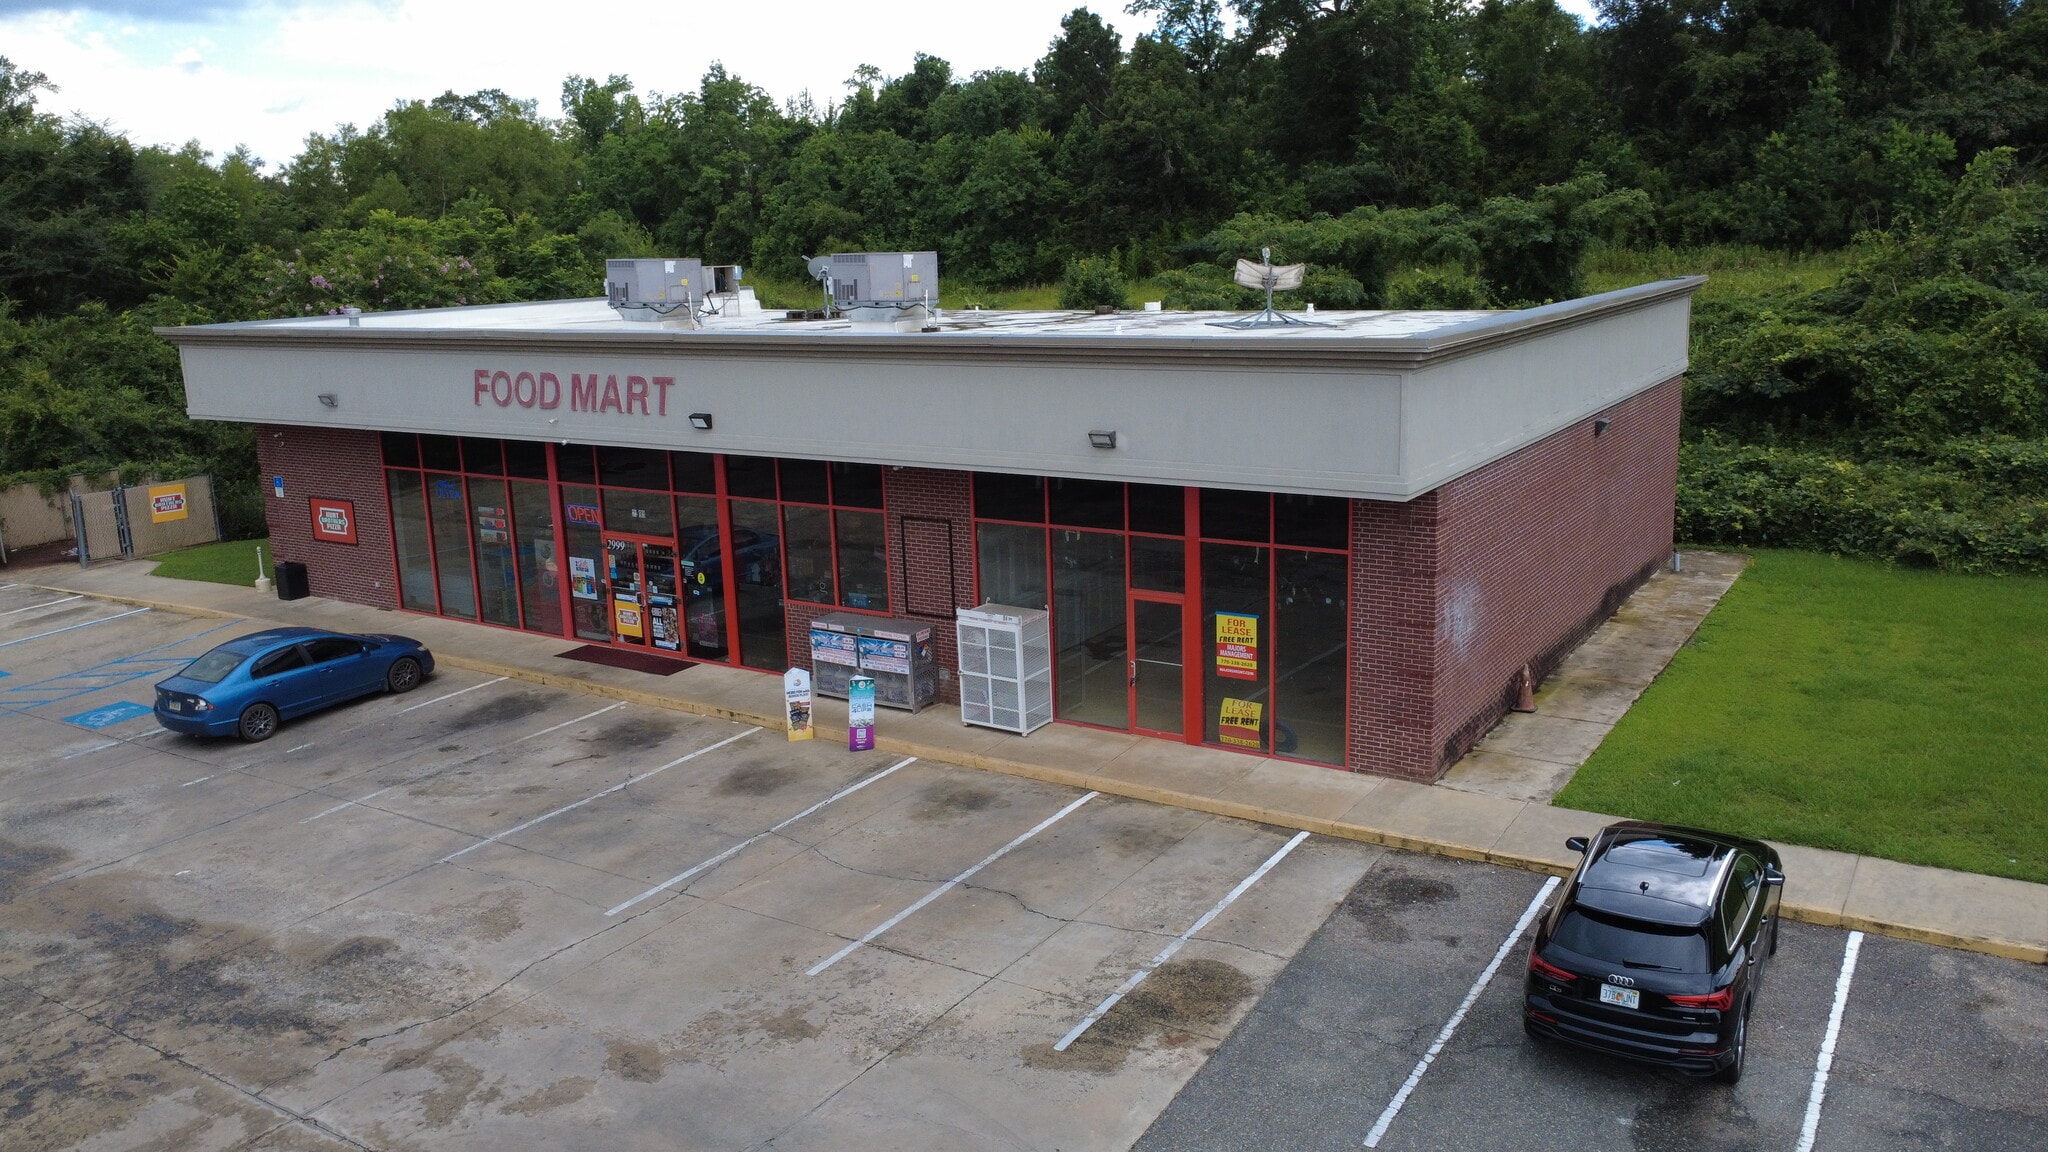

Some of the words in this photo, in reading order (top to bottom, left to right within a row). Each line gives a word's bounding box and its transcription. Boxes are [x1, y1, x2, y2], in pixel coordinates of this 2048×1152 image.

[474, 369, 561, 410] FOOD
[571, 373, 676, 416] MART
[568, 505, 600, 523] OPEN
[321, 516, 346, 526] BROTHERS
[327, 523, 341, 531] PIZZA
[607, 540, 626, 551] 2999
[1227, 618, 1246, 628] FOR
[1221, 626, 1252, 637] LEASE
[1226, 644, 1247, 653] MAJORS
[1220, 649, 1254, 660] MANAGEMENT
[1231, 700, 1253, 710] FOR
[1225, 706, 1257, 718] LEASE
[1221, 716, 1239, 725] FREE
[1241, 717, 1259, 726] RENT
